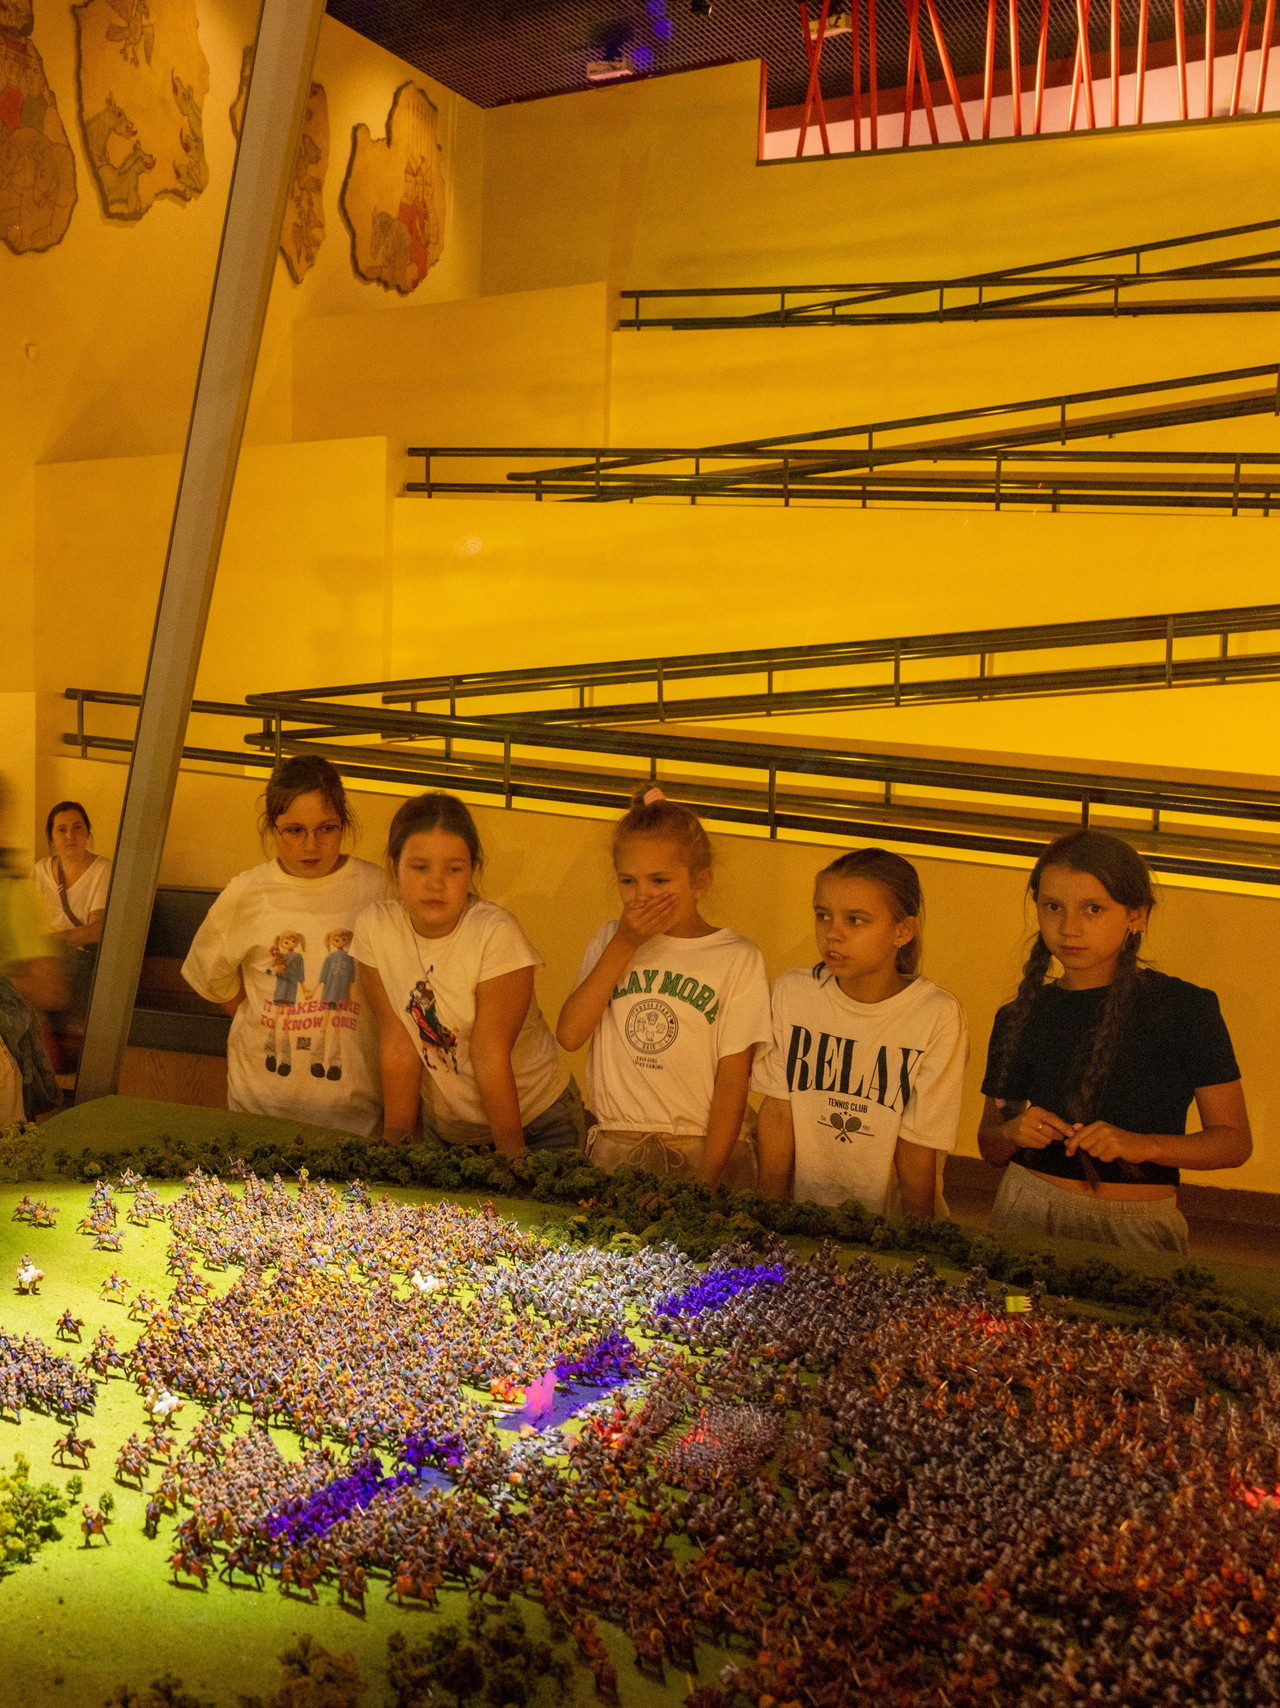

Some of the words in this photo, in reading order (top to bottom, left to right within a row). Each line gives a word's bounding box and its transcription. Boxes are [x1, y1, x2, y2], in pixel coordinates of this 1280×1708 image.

[608, 969, 659, 1003] LAY
[263, 998, 274, 1013] IT
[280, 998, 329, 1016] TAKES
[260, 1014, 276, 1030] TO
[282, 1016, 324, 1031] KNOW
[331, 1015, 357, 1031] ONE
[786, 1024, 925, 1115] RELAX
[828, 1097, 850, 1110] TENNIS
[850, 1102, 868, 1114] CLUB
